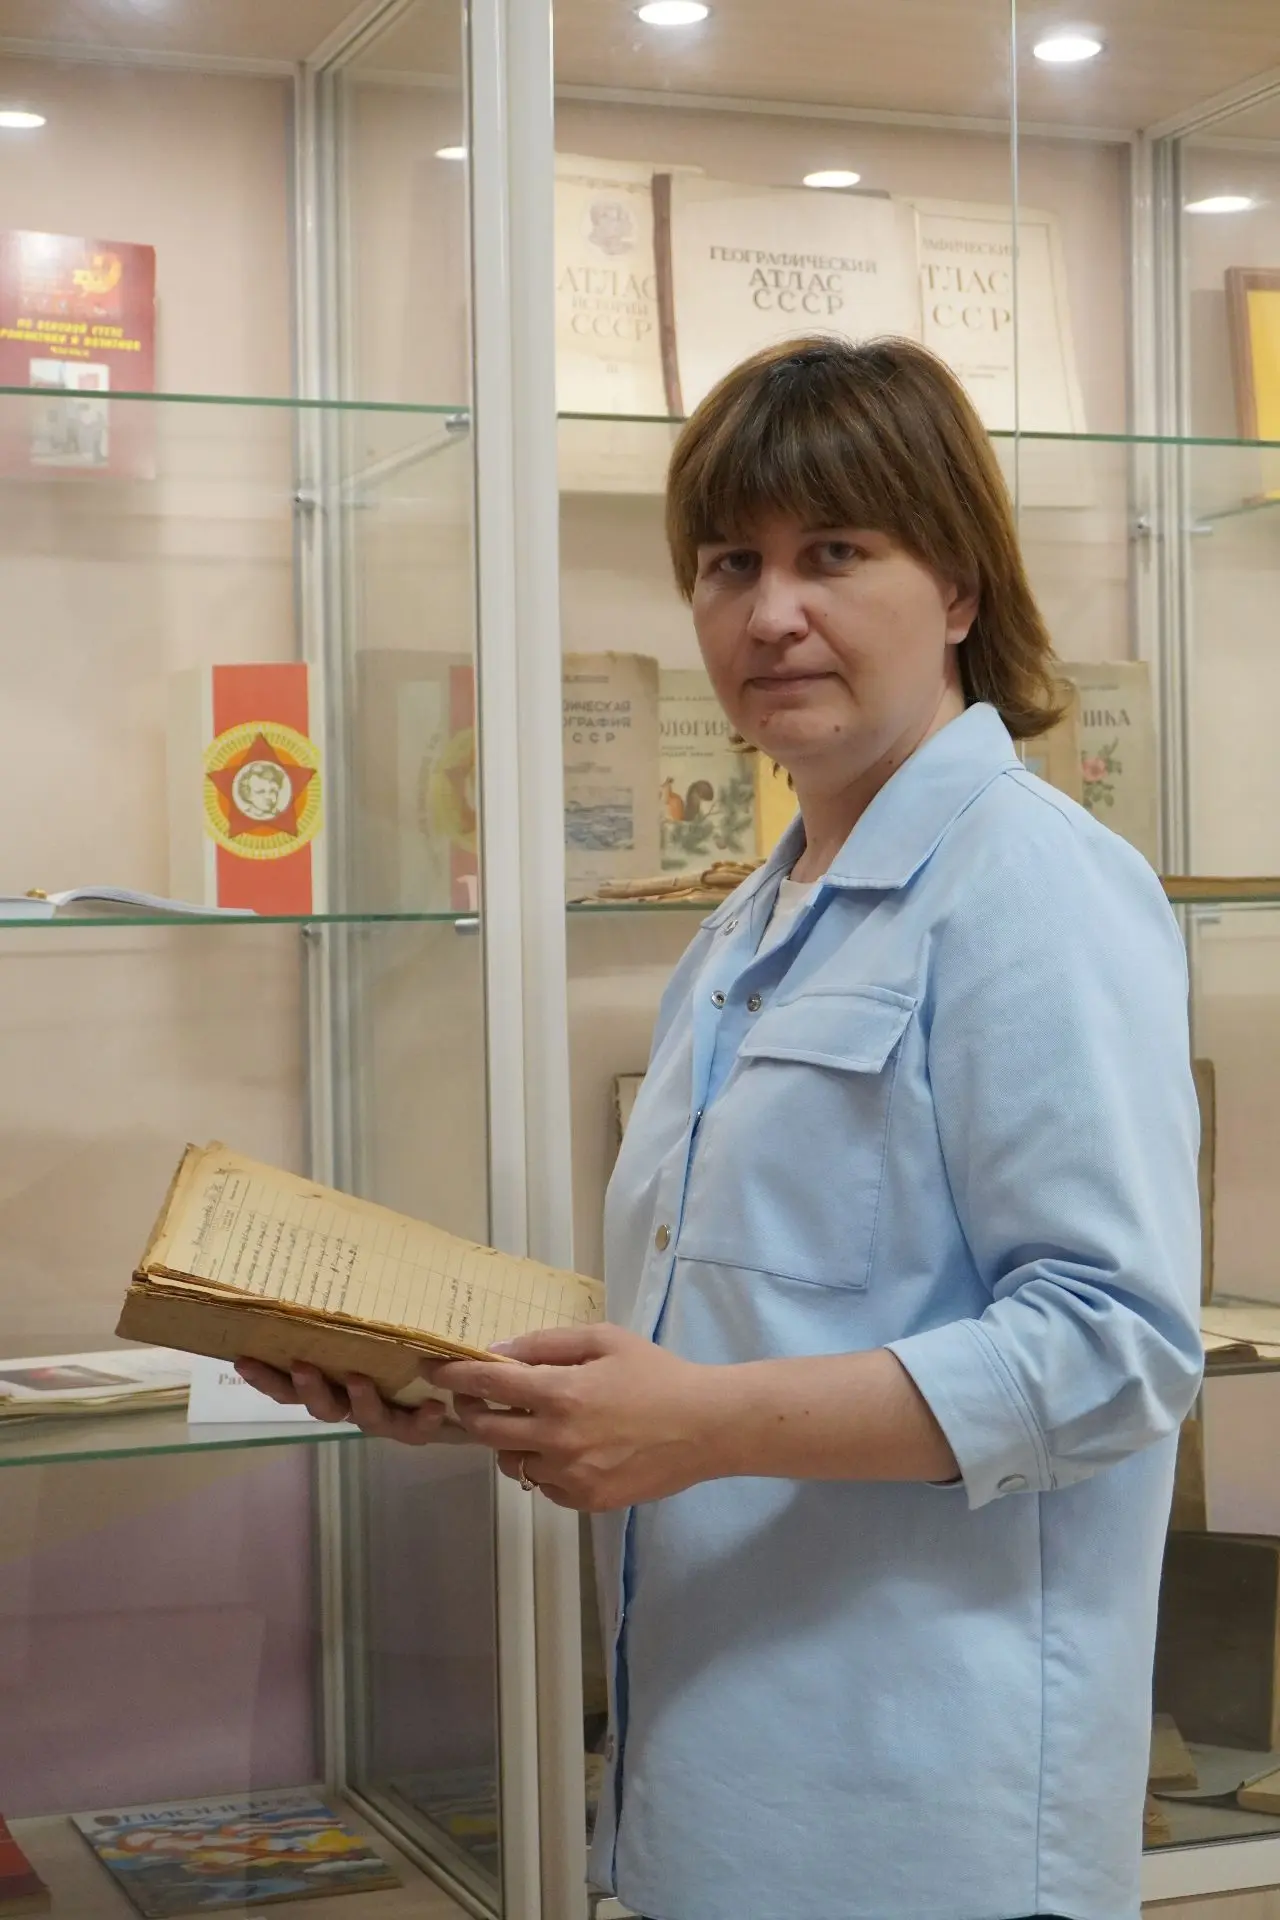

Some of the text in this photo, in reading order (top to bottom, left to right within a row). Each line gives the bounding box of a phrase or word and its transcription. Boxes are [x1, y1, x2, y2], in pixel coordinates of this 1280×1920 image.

[709, 245, 878, 274] ГЕОГРАФИЧЕСКИЙ
[556, 266, 656, 300] АТЛАС
[748, 267, 844, 293] АТЛАС
[753, 288, 844, 316] СССР
[571, 313, 652, 342] СССР
